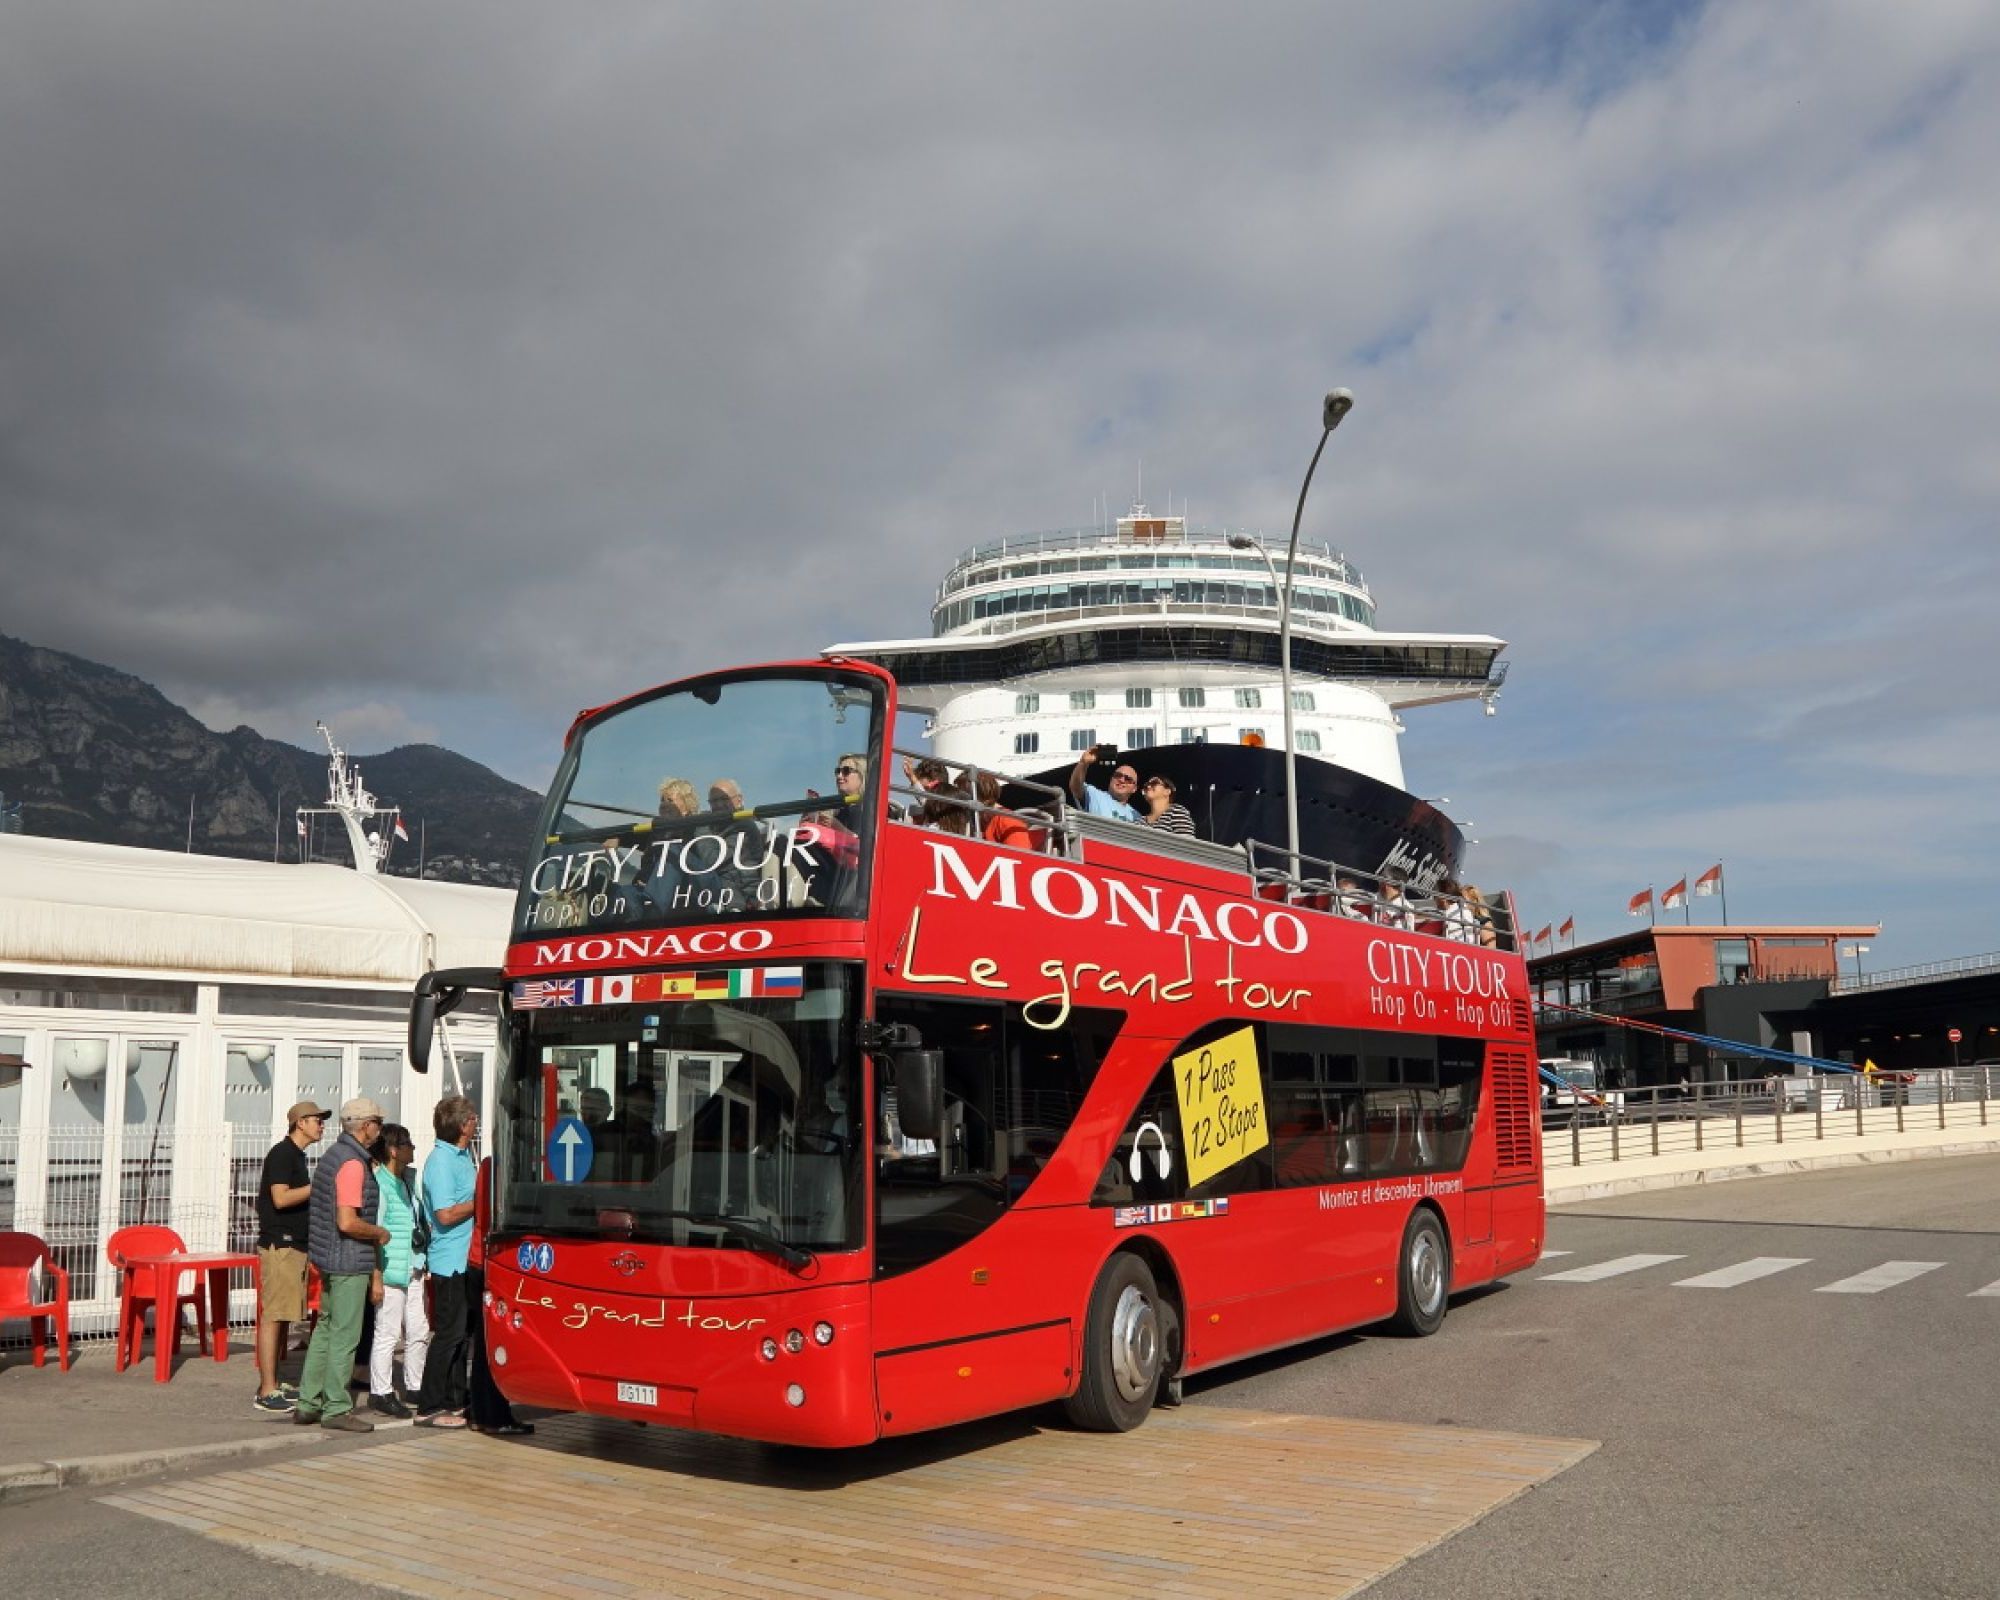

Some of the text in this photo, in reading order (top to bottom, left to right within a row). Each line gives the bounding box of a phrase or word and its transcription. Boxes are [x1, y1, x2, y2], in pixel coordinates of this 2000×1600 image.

[530, 825, 821, 896] CITY TOUR
[525, 903, 575, 929] Hop
[590, 893, 627, 916] On
[672, 884, 735, 915] Hop
[757, 874, 816, 902] Off
[923, 840, 1309, 955] MONACO
[534, 928, 774, 966] MONACO
[901, 906, 1312, 1030] Le grand tour
[1367, 939, 1510, 1000] CITY TOUR
[1370, 986, 1406, 1024] Hop
[1413, 991, 1437, 1019] On
[1456, 997, 1485, 1032] Hop
[1490, 1001, 1513, 1027] Off
[1184, 1049, 1237, 1107] 1 Pass
[1191, 1094, 1259, 1160] 12 Stops
[1319, 1188, 1358, 1210] Montez
[1361, 1186, 1372, 1205] et
[1374, 1180, 1422, 1203] descendez
[514, 1278, 767, 1331] Le grand tour
